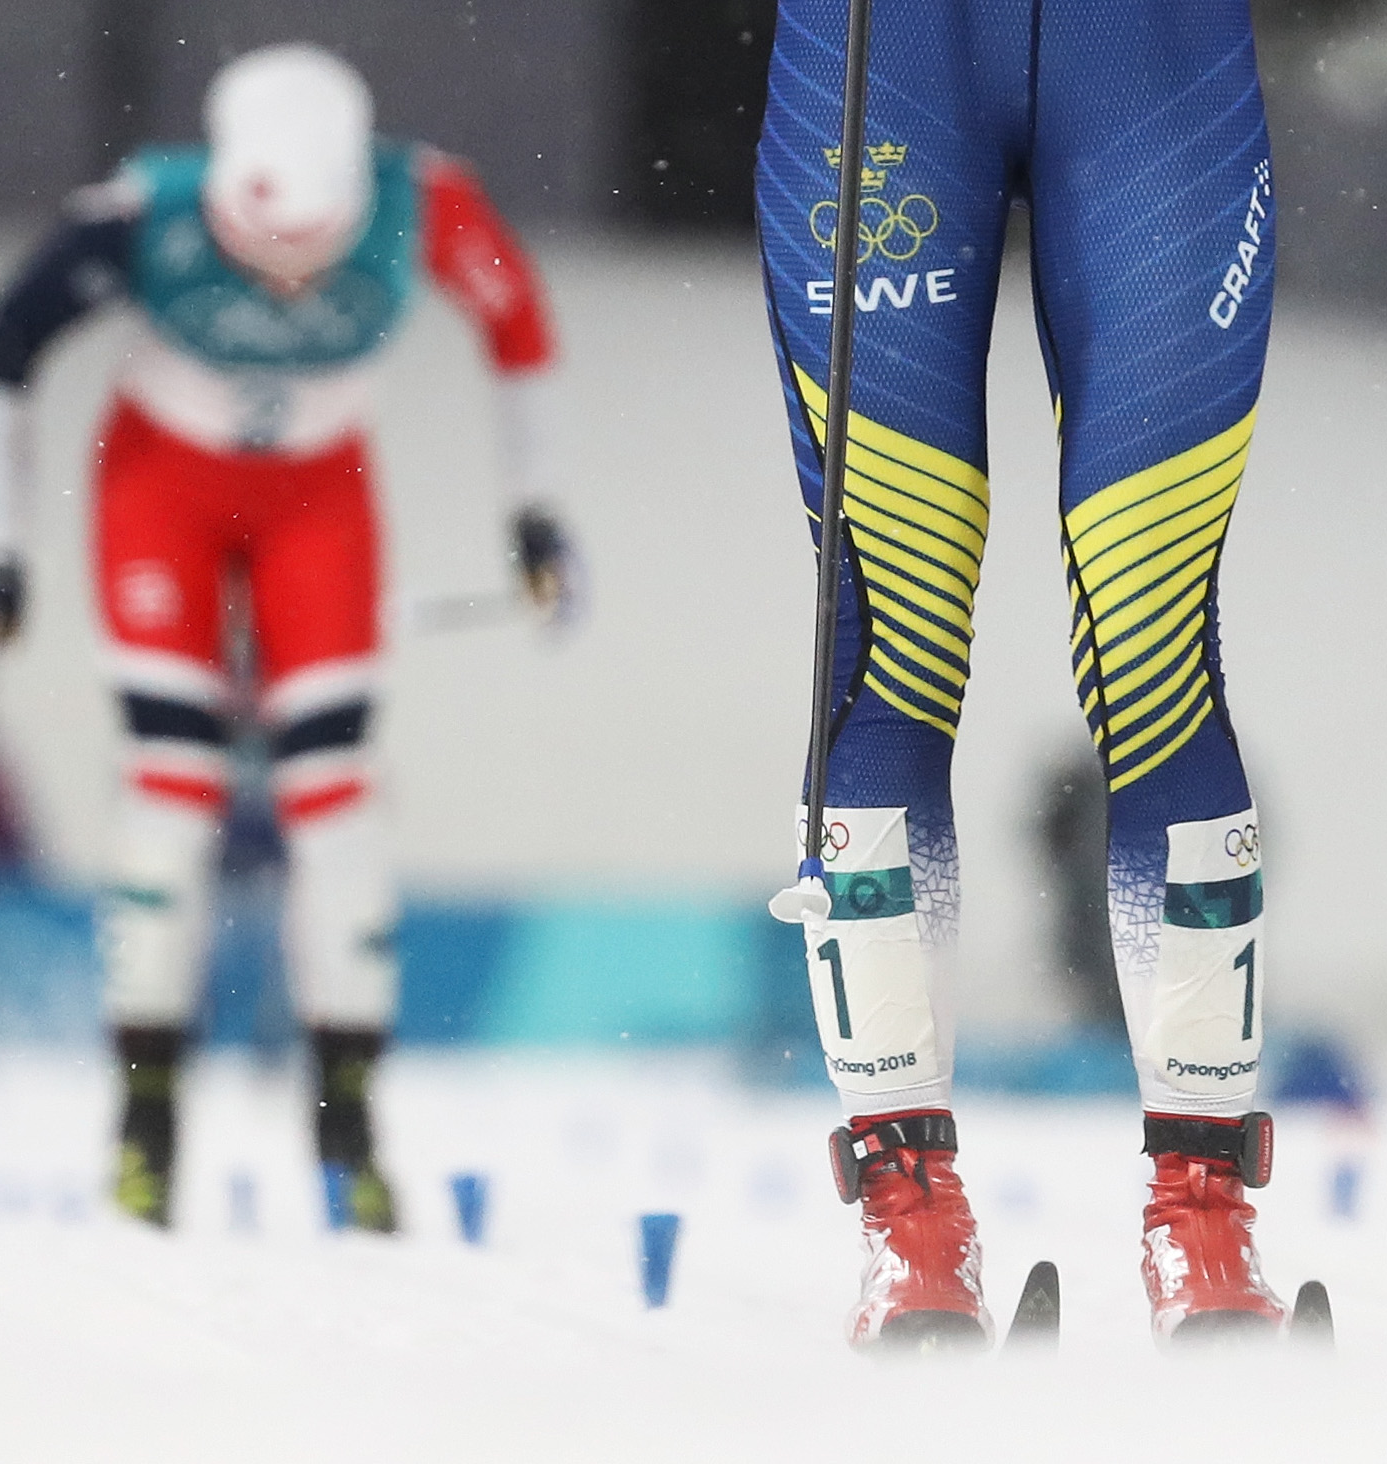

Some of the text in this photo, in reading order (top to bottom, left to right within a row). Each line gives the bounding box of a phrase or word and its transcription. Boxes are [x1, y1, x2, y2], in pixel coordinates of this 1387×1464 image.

[806, 268, 957, 315] SWE
[1209, 187, 1268, 330] CRAFT
[817, 938, 853, 1040] 1
[1233, 938, 1256, 1041] 1
[877, 1052, 917, 1072] 2018
